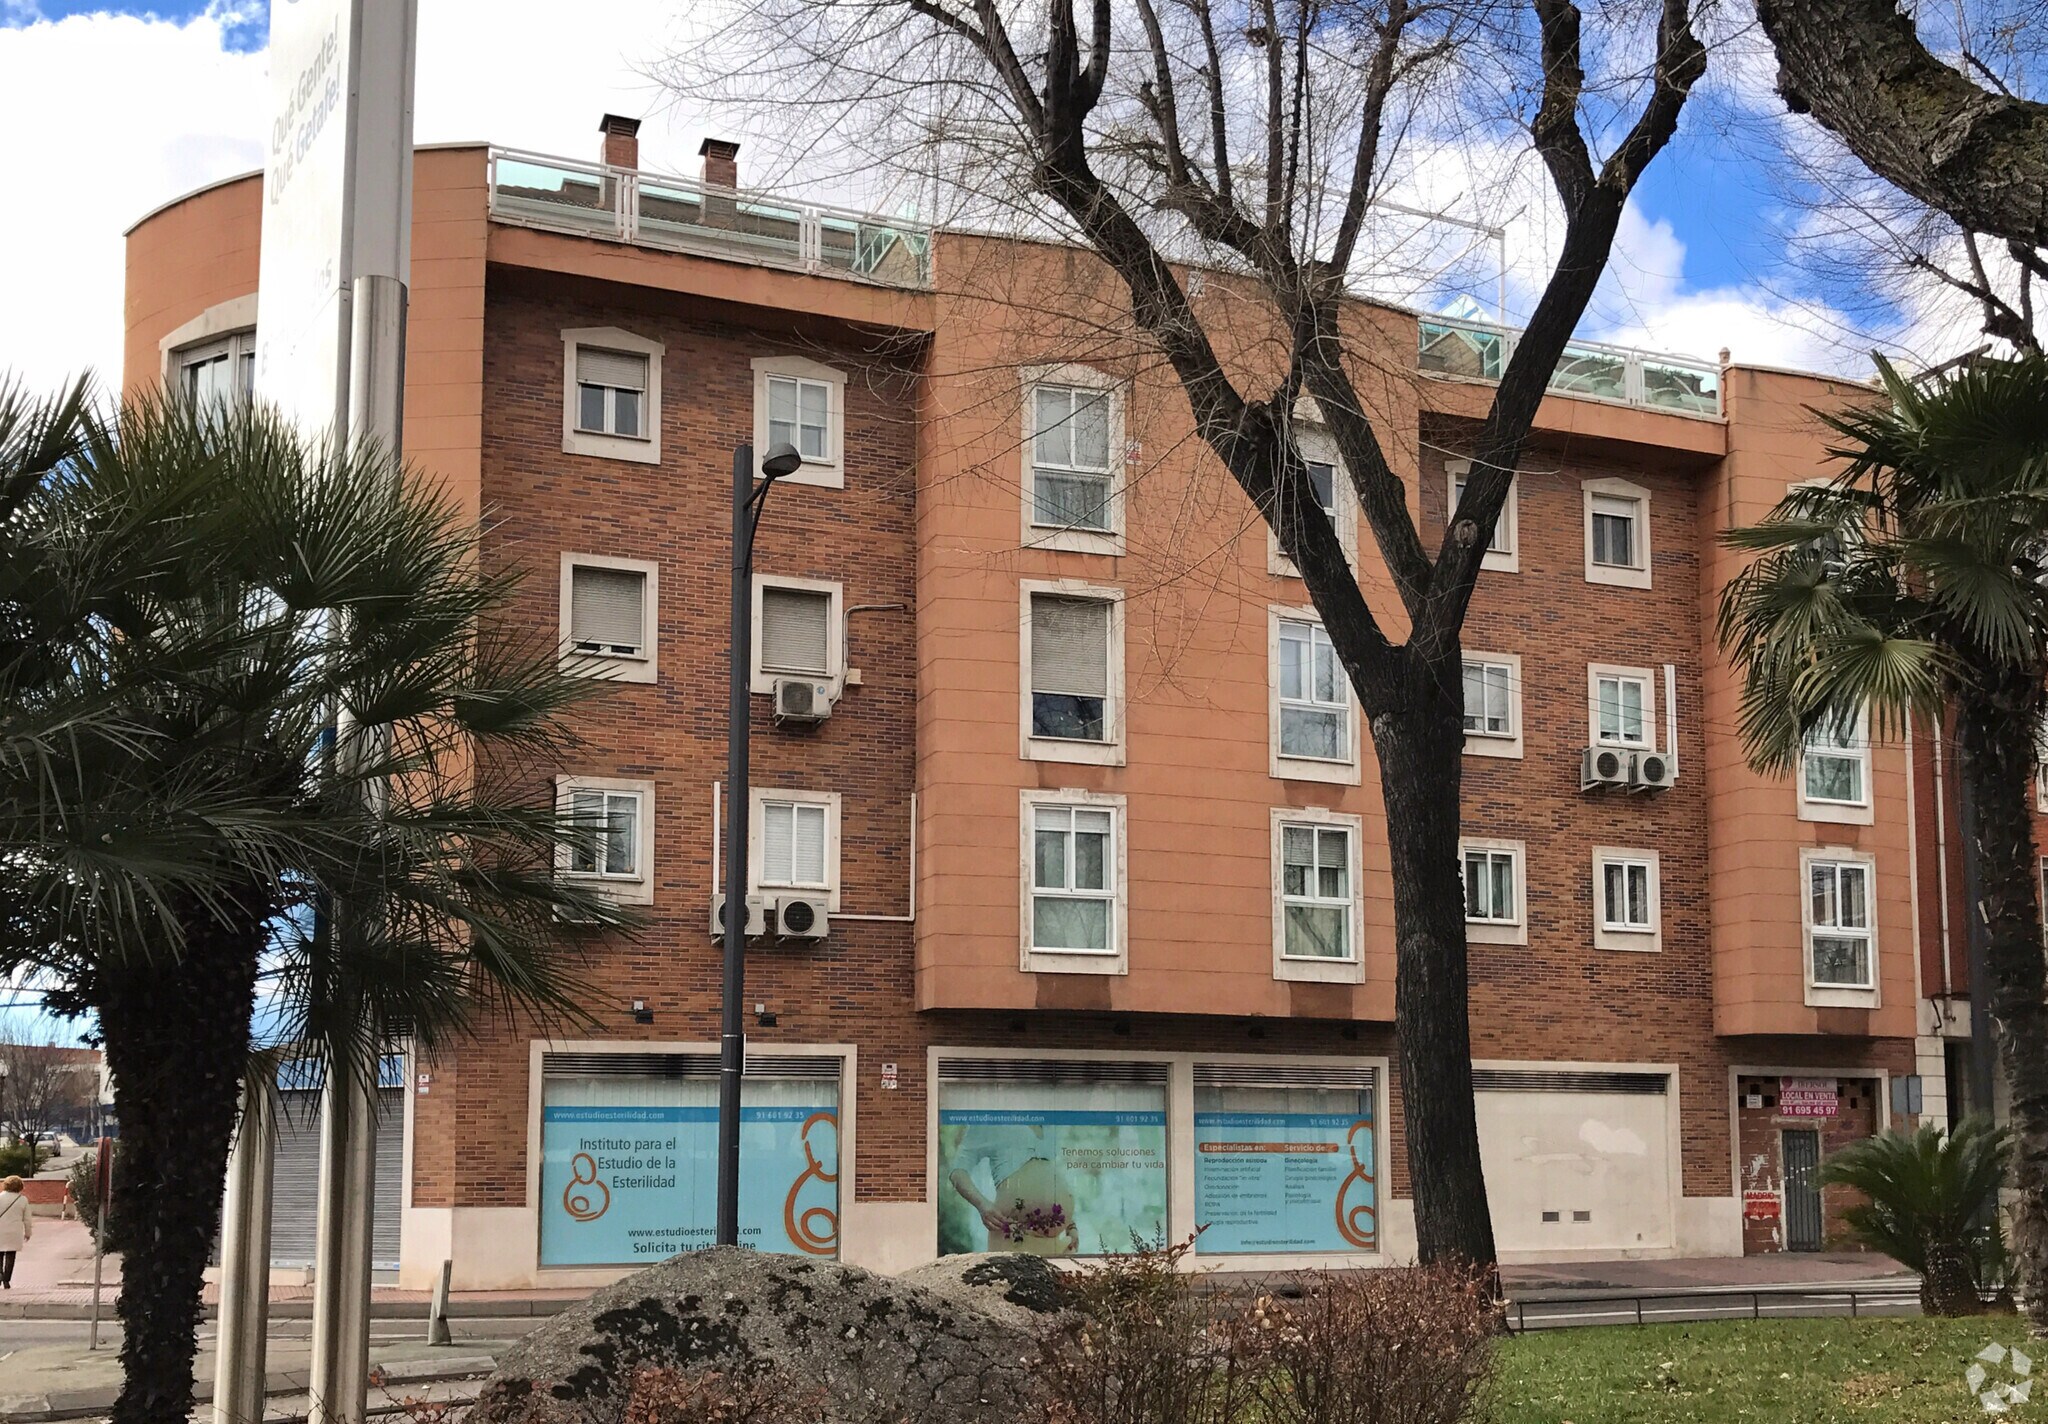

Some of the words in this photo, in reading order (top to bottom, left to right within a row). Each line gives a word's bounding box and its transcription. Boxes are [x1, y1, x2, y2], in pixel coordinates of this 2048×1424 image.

[272, 87, 295, 156] Qué
[297, 13, 339, 113] Gente!
[270, 140, 294, 205] Qué
[296, 61, 341, 165] Getafe!
[1781, 1091, 1803, 1100] LOCAL
[1804, 1091, 1813, 1100] EN
[1815, 1092, 1836, 1100] VENTA
[553, 1111, 665, 1120] www.estudioesterilidad.com
[756, 1111, 765, 1119] 91
[1782, 1106, 1793, 1115] 91
[1795, 1106, 1812, 1115] 695
[1813, 1106, 1824, 1115] 45
[1825, 1106, 1836, 1115] 97
[580, 1137, 631, 1150] Instituto
[634, 1140, 662, 1153] para
[665, 1136, 677, 1150] el
[1204, 1142, 1253, 1152] Especialistas
[1254, 1144, 1266, 1152] en:
[1284, 1143, 1315, 1152] Servicio
[1061, 1147, 1104, 1156] Tenemos
[1106, 1147, 1156, 1156] soluciones
[597, 1156, 643, 1169] Estudio
[646, 1155, 662, 1169] de
[665, 1156, 676, 1169] la
[1066, 1161, 1088, 1170] para
[1090, 1160, 1129, 1169] cambiar
[1132, 1161, 1142, 1169] tu
[1144, 1160, 1165, 1169] vida
[612, 1174, 676, 1188] Esterilidad
[628, 1226, 761, 1237] www.estudioesteri.com
[633, 1242, 676, 1254] Solicita
[680, 1241, 692, 1252] tu
